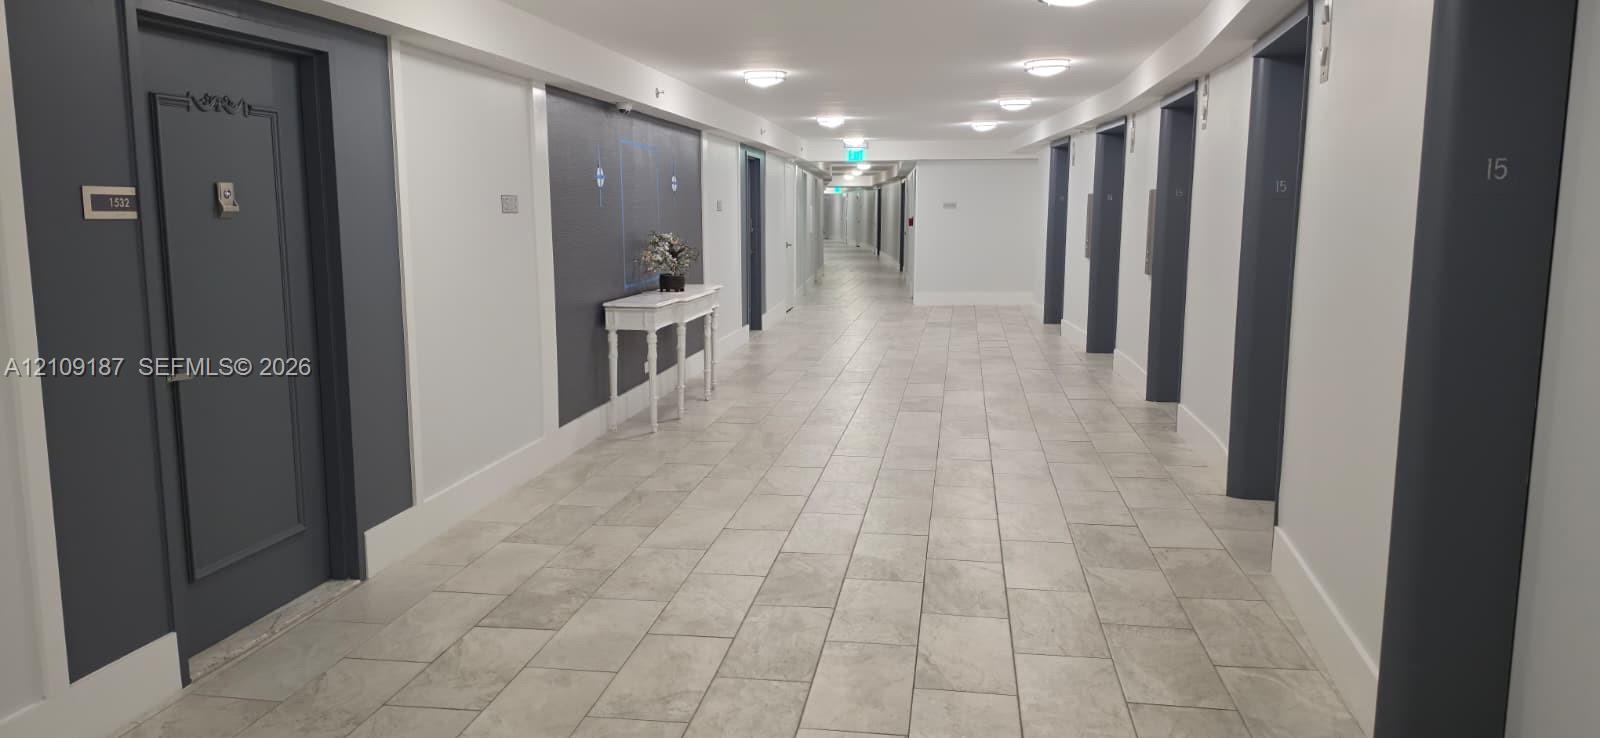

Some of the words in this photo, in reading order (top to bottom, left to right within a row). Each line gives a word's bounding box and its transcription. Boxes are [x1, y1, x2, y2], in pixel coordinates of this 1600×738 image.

[1487, 157, 1508, 180] 15
[1276, 179, 1288, 192] 15
[109, 197, 130, 208] 1532
